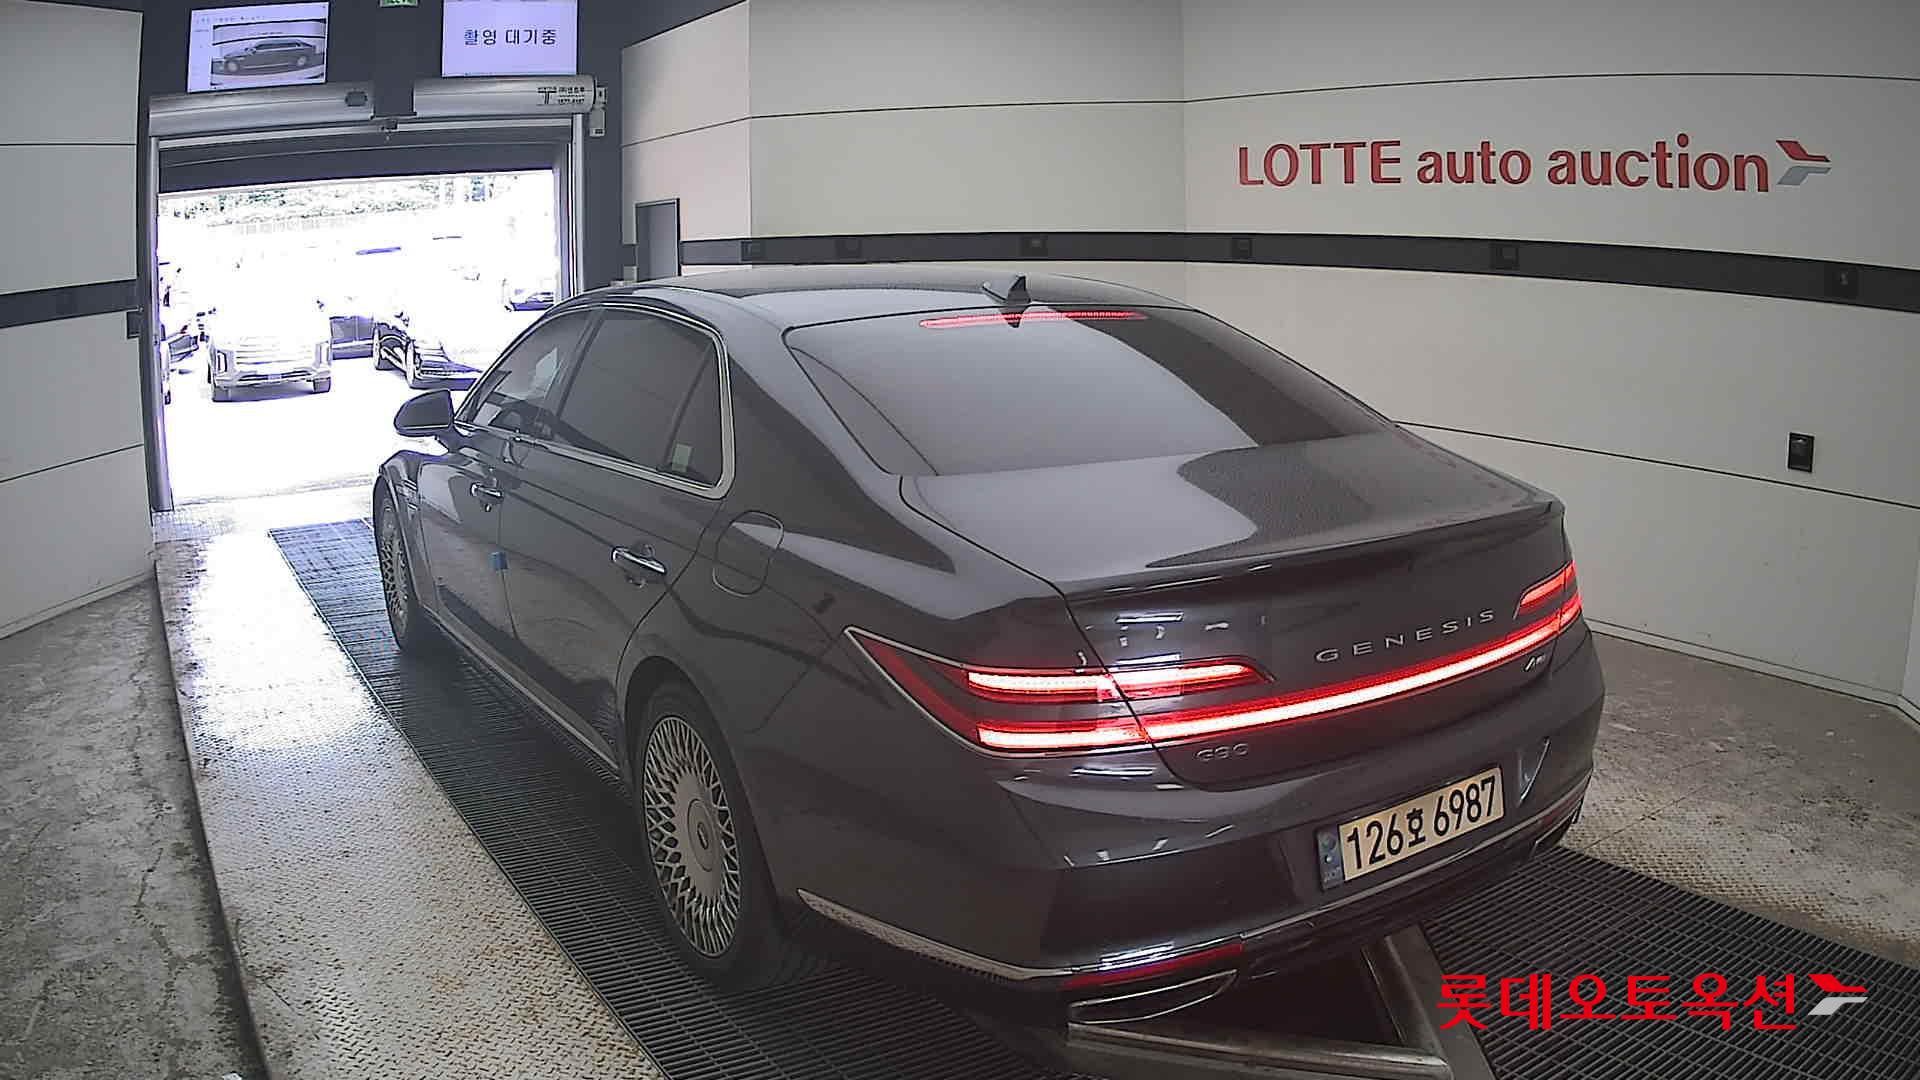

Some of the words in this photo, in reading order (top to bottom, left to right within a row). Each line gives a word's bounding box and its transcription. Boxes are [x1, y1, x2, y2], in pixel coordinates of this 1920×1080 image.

[464, 29, 497, 46] 촬영
[505, 29, 557, 46] 대기중
[1238, 140, 1401, 187] LOTTE
[1416, 140, 1532, 186] auto
[1547, 133, 1770, 193] auction
[1315, 608, 1495, 663] GENESIS
[1346, 807, 1427, 870] 126호
[1433, 775, 1496, 837] 6987
